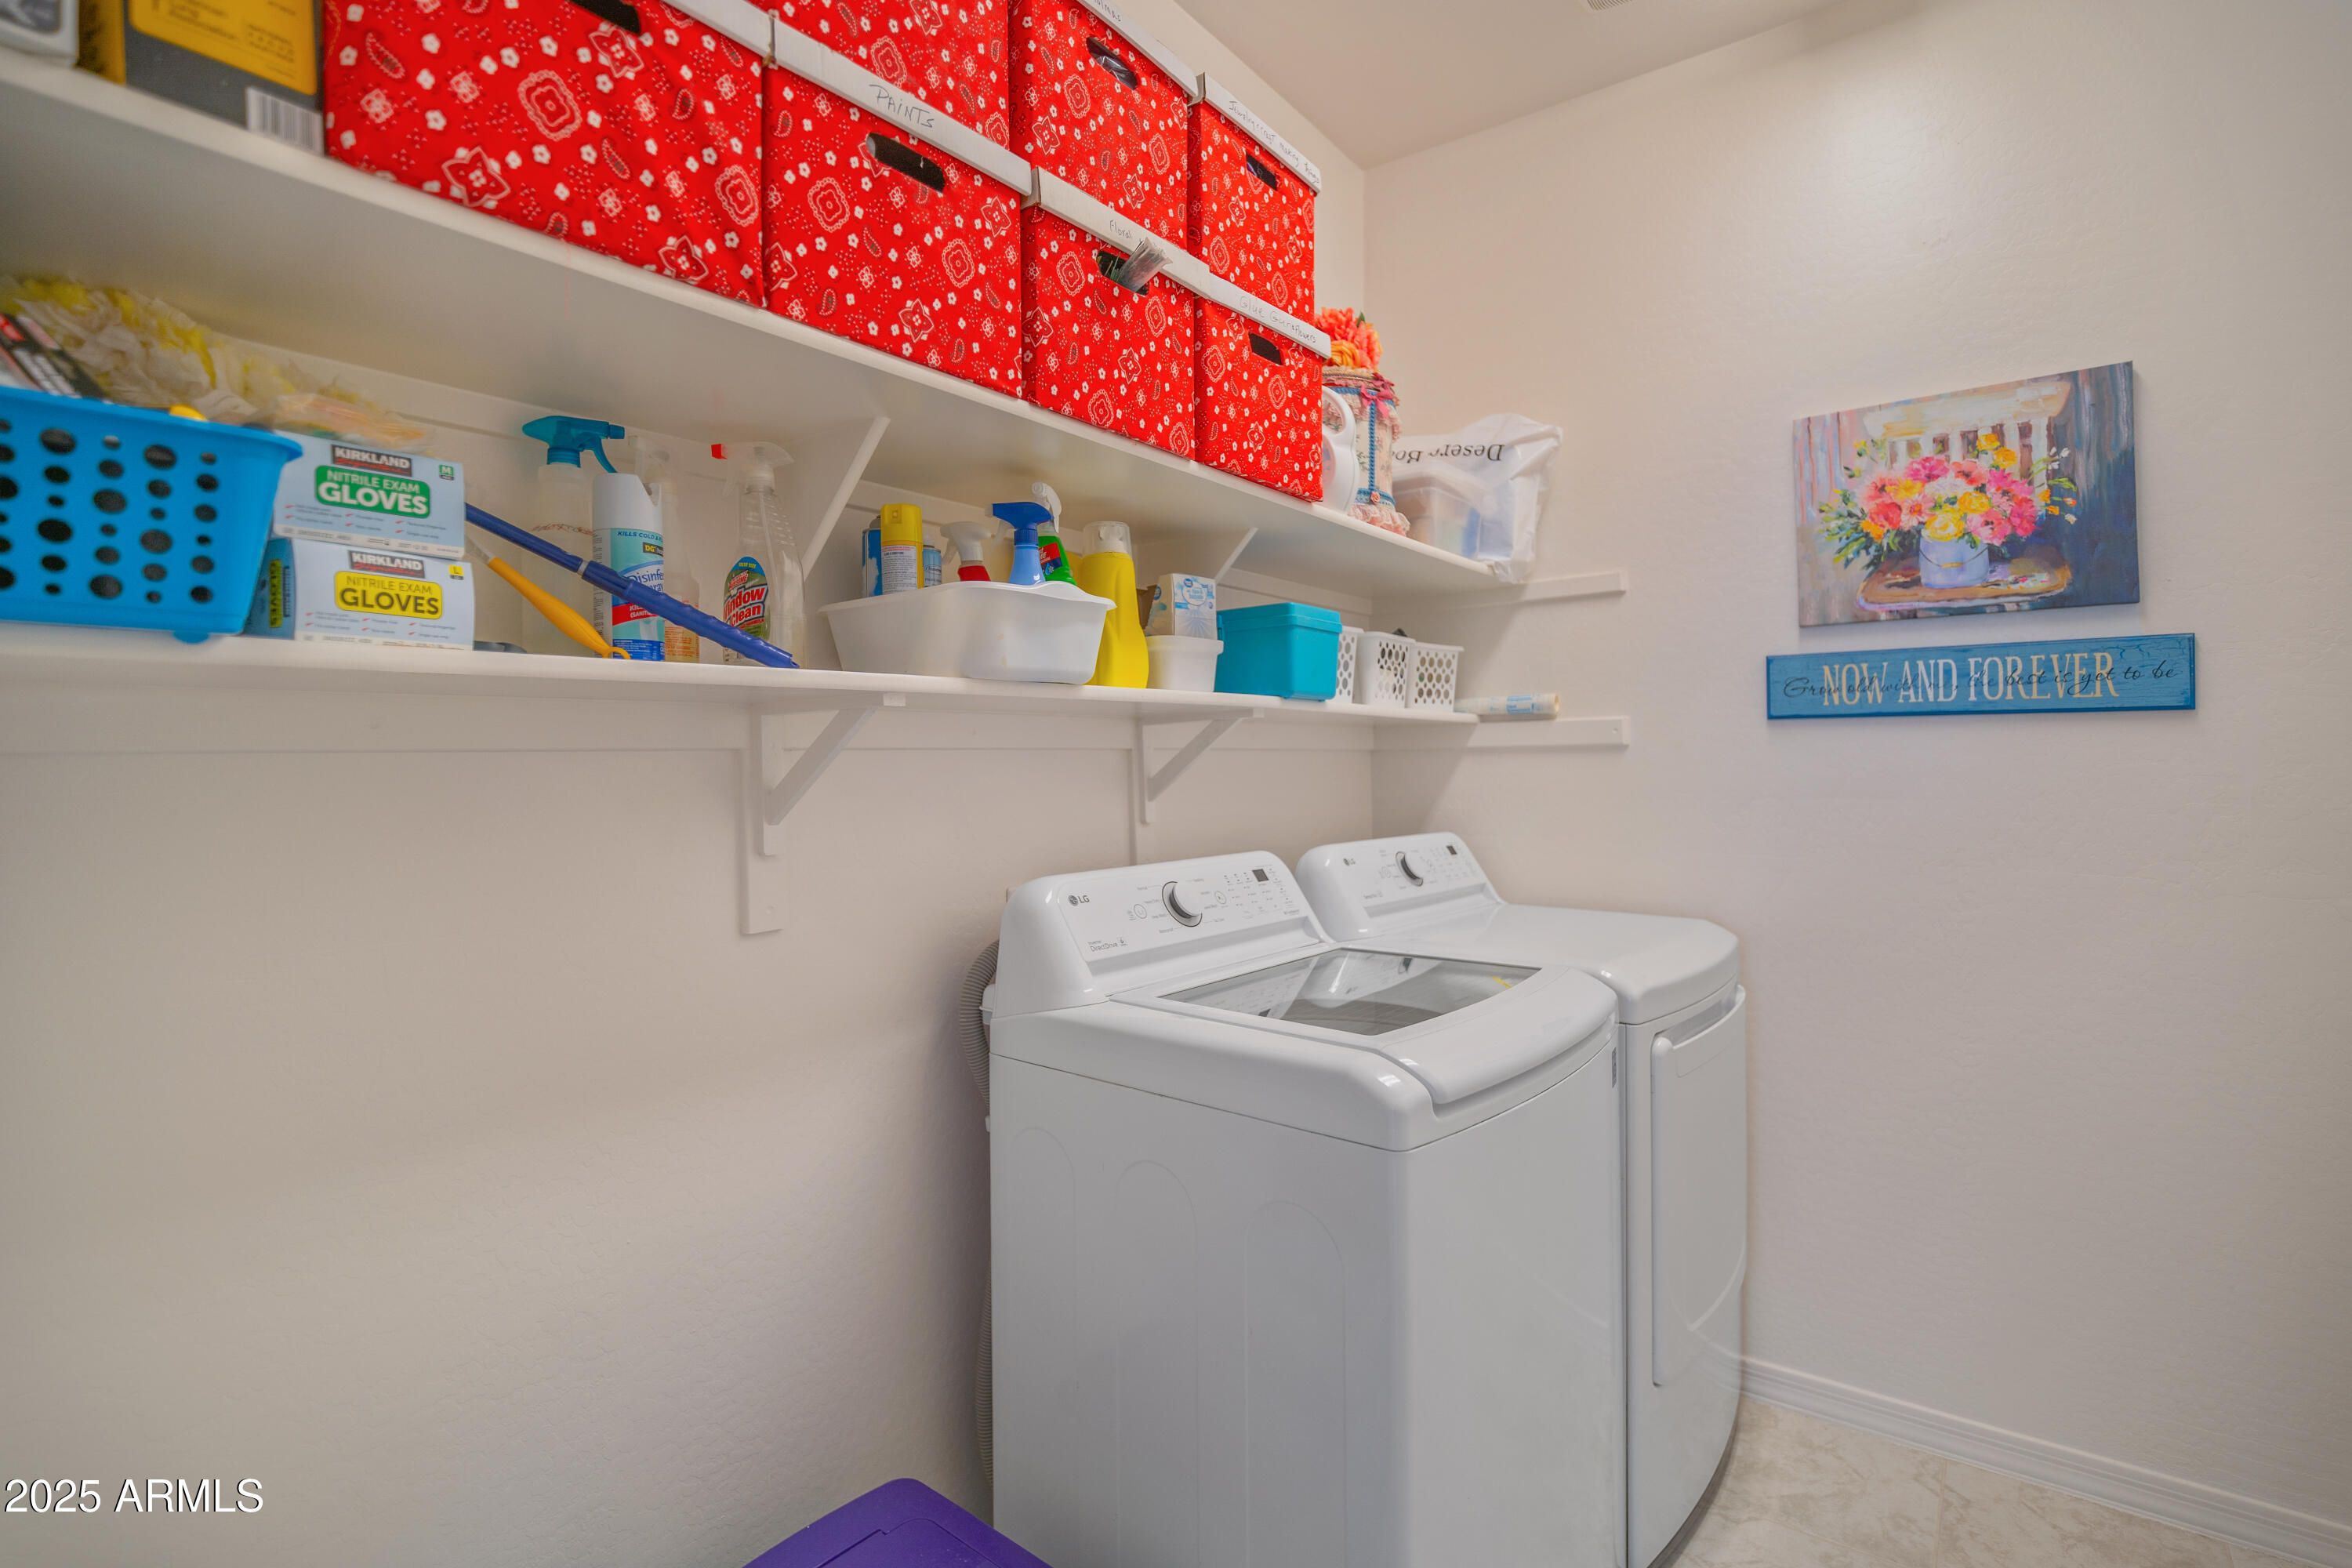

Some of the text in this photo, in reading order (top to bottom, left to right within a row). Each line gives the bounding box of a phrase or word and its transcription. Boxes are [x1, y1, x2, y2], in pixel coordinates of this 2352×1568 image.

[1109, 219, 1132, 239] Floral
[1240, 296, 1265, 318] Glue
[335, 446, 410, 469] KIRKLAND
[326, 469, 420, 494] NITRILE EXAM
[441, 465, 452, 475] M
[318, 481, 428, 515] GLOVES
[644, 544, 655, 553] DG
[351, 552, 423, 571] KIRKLAND
[346, 575, 433, 595] NITRILE EXAM
[339, 587, 440, 615] GLOVES
[723, 586, 766, 623] Window
[731, 604, 761, 627] Clean
[1783, 677, 1840, 699] Grow
[1847, 677, 1877, 693] old
[1882, 672, 1921, 692] with
[1965, 669, 1998, 688] the
[2005, 667, 2047, 686] best
[2054, 670, 2072, 683] is
[2067, 667, 2116, 695] yet
[2123, 666, 2145, 681] to
[2152, 660, 2182, 679] be
[1822, 652, 2120, 706] NOW AND FOREVER
